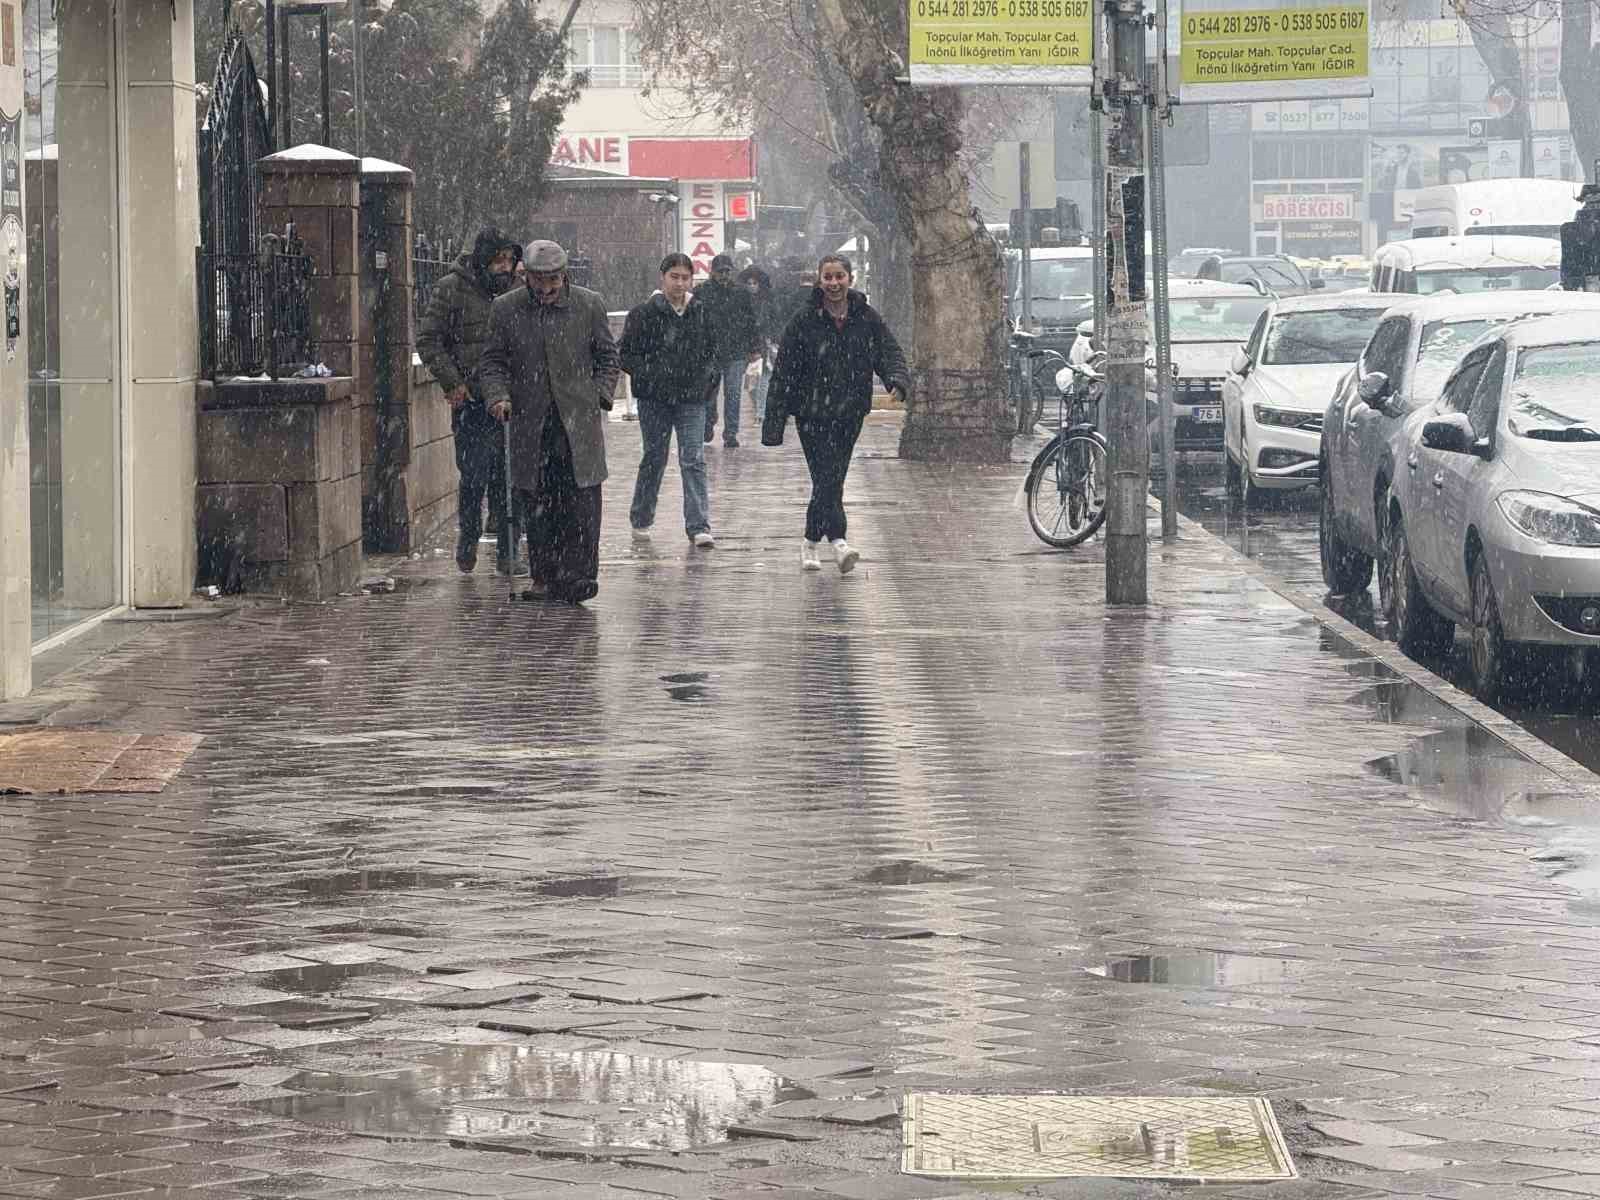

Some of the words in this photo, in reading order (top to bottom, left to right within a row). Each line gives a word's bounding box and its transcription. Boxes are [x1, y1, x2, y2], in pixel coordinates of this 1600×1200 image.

[918, 1, 926, 17] 0
[929, 1, 949, 17] 544
[952, 1, 969, 17] 281
[972, 1, 999, 17] 2976
[1008, 1, 1016, 17] 0
[1019, 1, 1039, 17] 538
[1041, 1, 1062, 17] 505
[1065, 1, 1088, 17] 6187
[1188, 18, 1196, 34] 0
[1199, 17, 1220, 34] 544
[1223, 16, 1240, 33] 281
[1244, 15, 1270, 33] 2976
[1281, 14, 1289, 32] 0
[1292, 13, 1312, 31] 538
[1315, 12, 1337, 30] 505
[1340, 11, 1364, 29] 6187
[926, 32, 973, 44] Topçular
[976, 32, 1002, 42] Mah.
[1005, 32, 1052, 44] Topçular
[1055, 32, 1079, 42] Cad.
[926, 45, 956, 57] İnönü
[960, 45, 1015, 59] İlköğretim
[1018, 46, 1041, 57] Yanı
[1048, 45, 1080, 57] IĞDIR
[1196, 48, 1244, 61] Topçular
[1247, 47, 1274, 58] Mah.
[1277, 45, 1325, 58] Topçular
[1329, 43, 1355, 54] Cad.
[1196, 62, 1228, 75] İnönü
[1231, 61, 1288, 75] İlköğretim
[1291, 60, 1315, 71] Yanı
[1322, 58, 1355, 71] IĞDIR
[553, 138, 620, 163] ANE
[731, 197, 747, 216] E
[689, 183, 715, 275] ECZAN
[1200, 408, 1213, 420] 76
